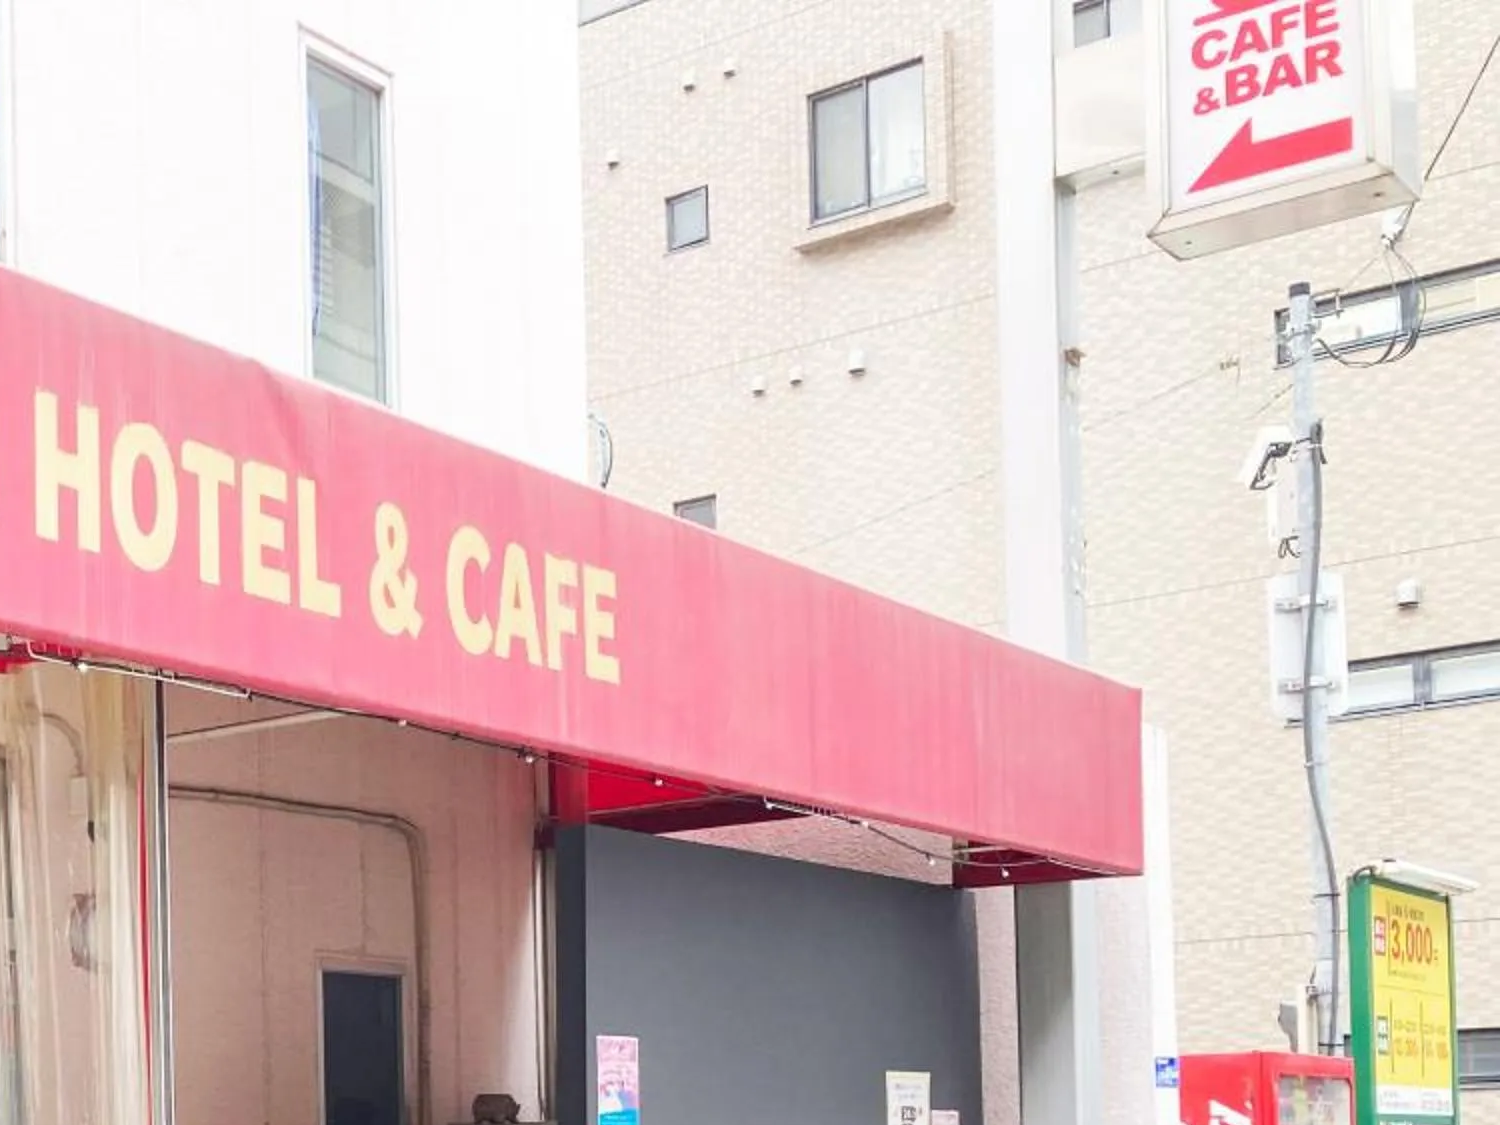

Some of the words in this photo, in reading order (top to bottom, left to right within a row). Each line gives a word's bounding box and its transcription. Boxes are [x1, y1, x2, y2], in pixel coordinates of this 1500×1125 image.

[1191, 0, 1340, 70] CAFE
[34, 390, 341, 617] HOTEL
[369, 502, 423, 638] &
[446, 525, 620, 684] CAFE
